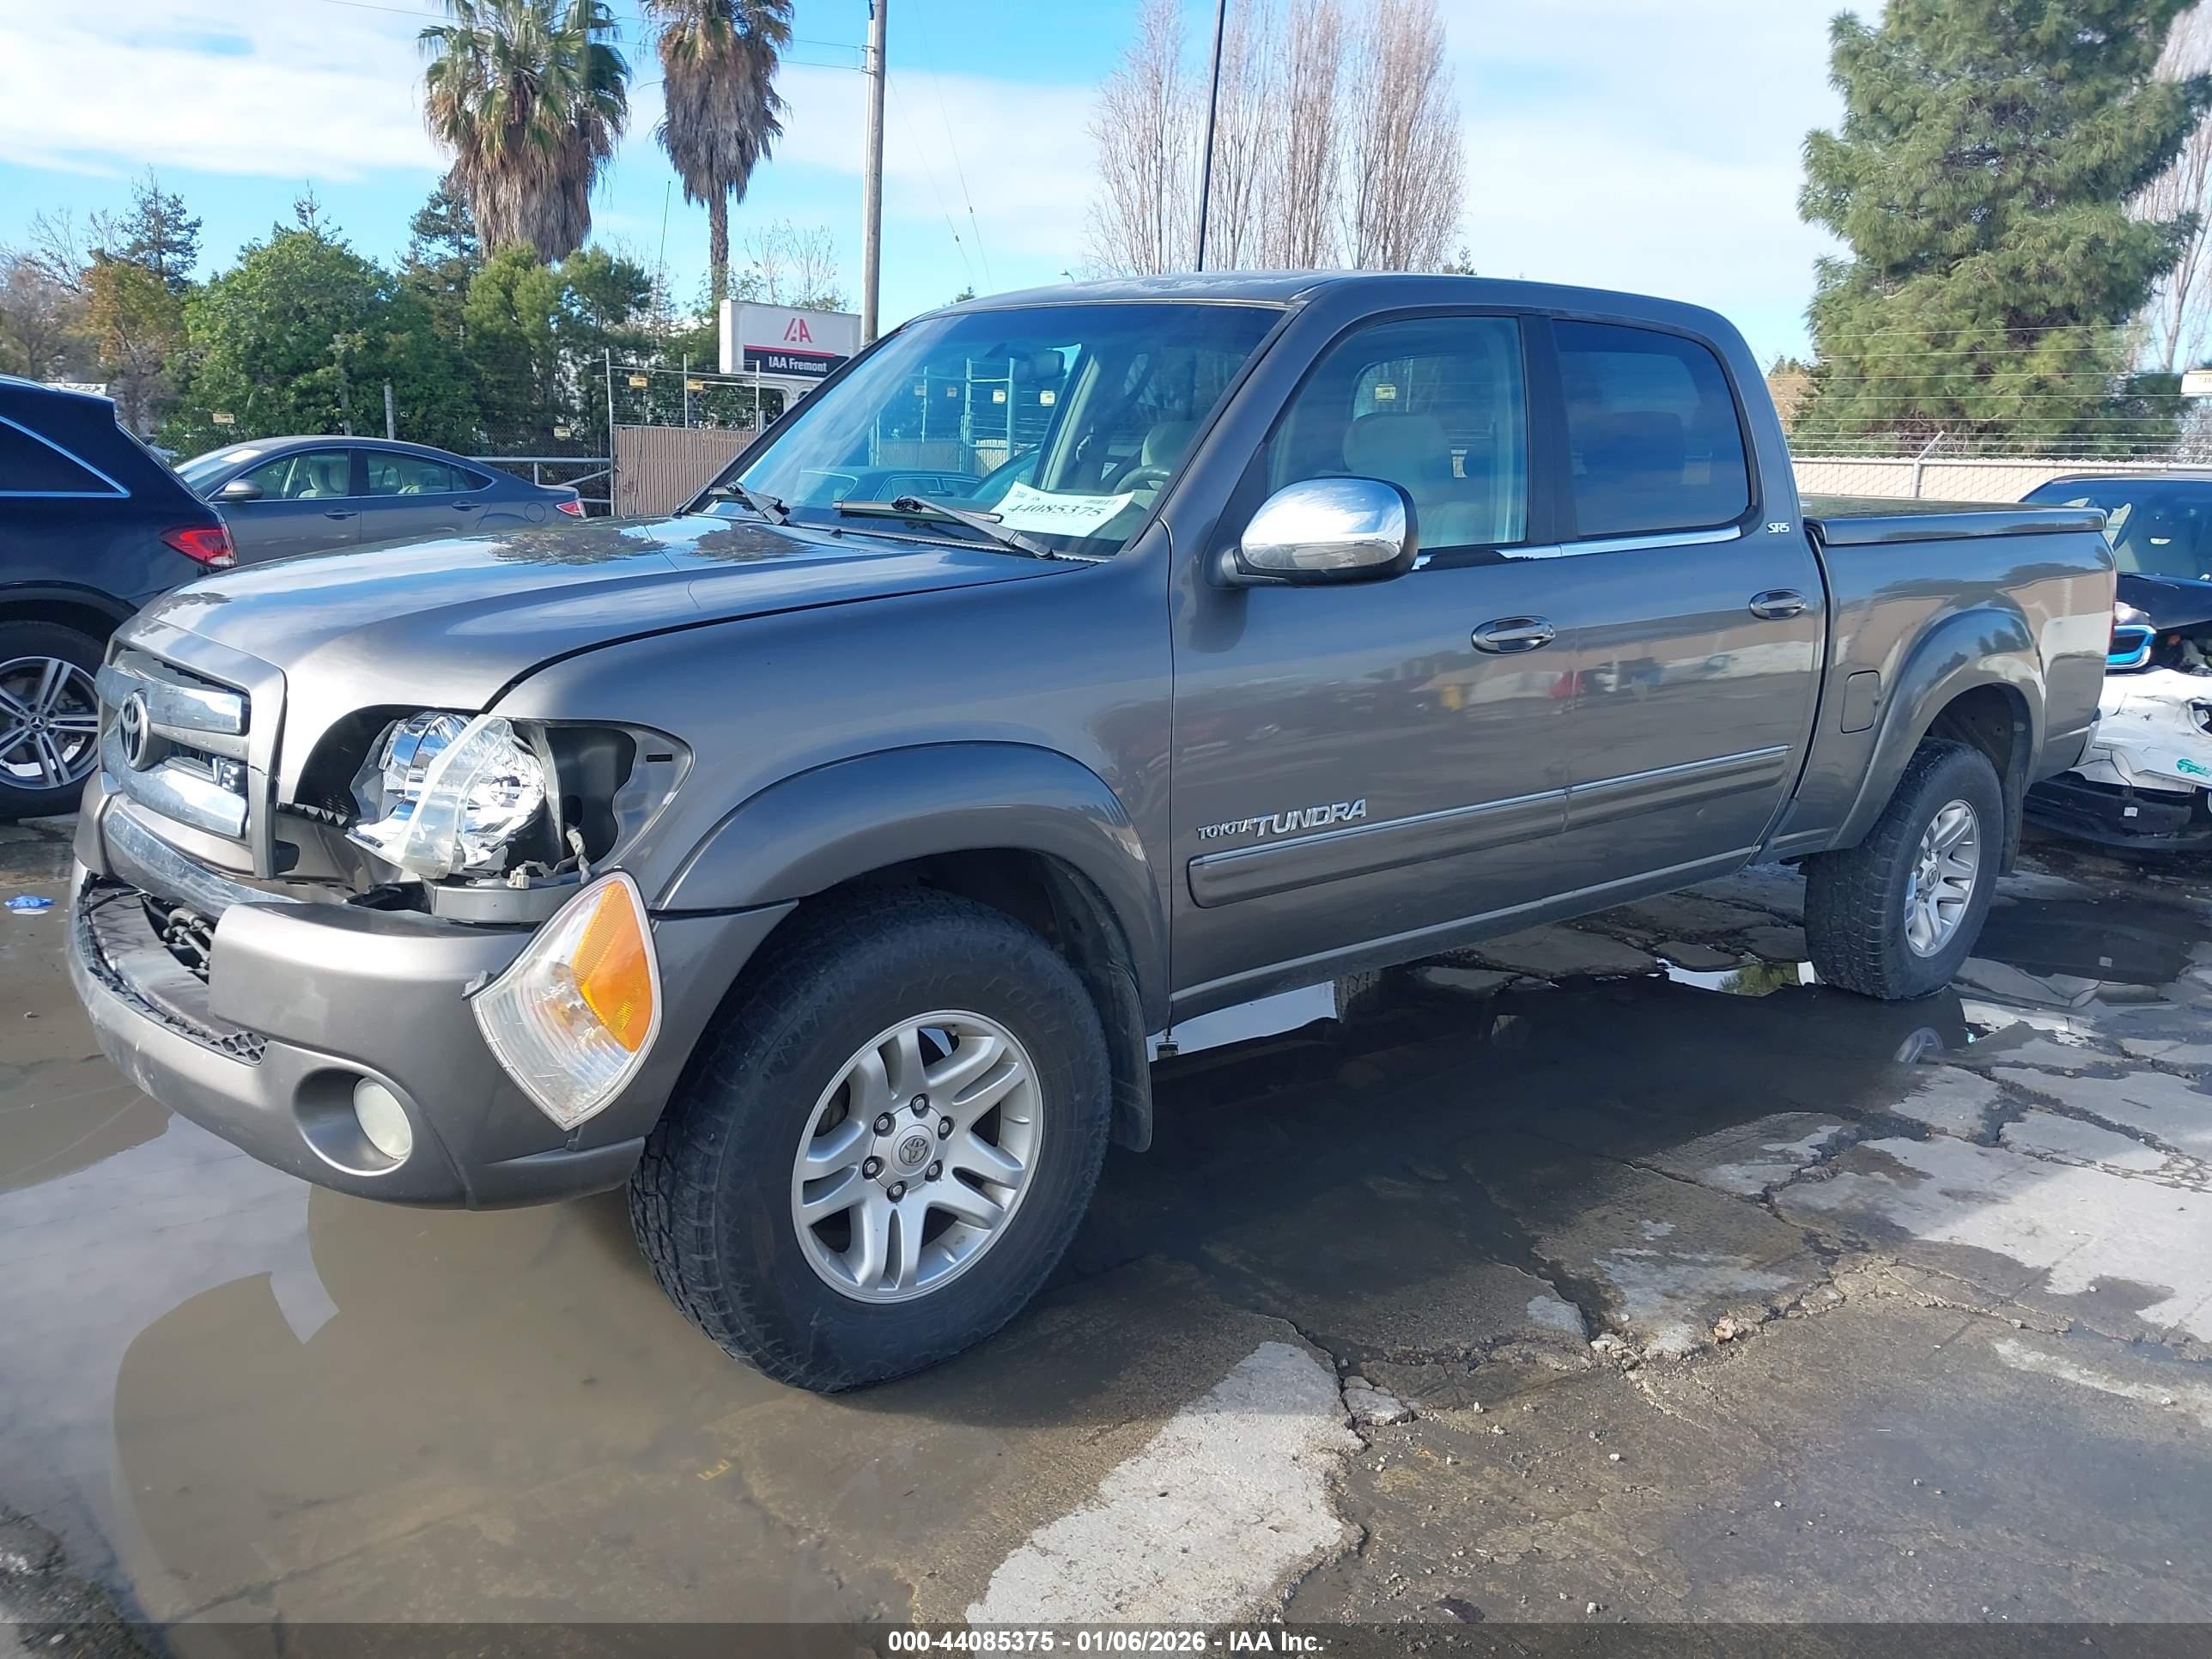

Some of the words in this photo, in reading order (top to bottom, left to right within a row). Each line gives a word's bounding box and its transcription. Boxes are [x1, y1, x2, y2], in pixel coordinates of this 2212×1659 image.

[769, 356, 787, 369] IAA
[789, 358, 828, 373] Fremont
[1007, 504, 1106, 517] 44085375
[1767, 522, 1790, 533] SR5
[1197, 818, 1255, 841] TOYOTA
[1253, 798, 1367, 838] TUNDRA
